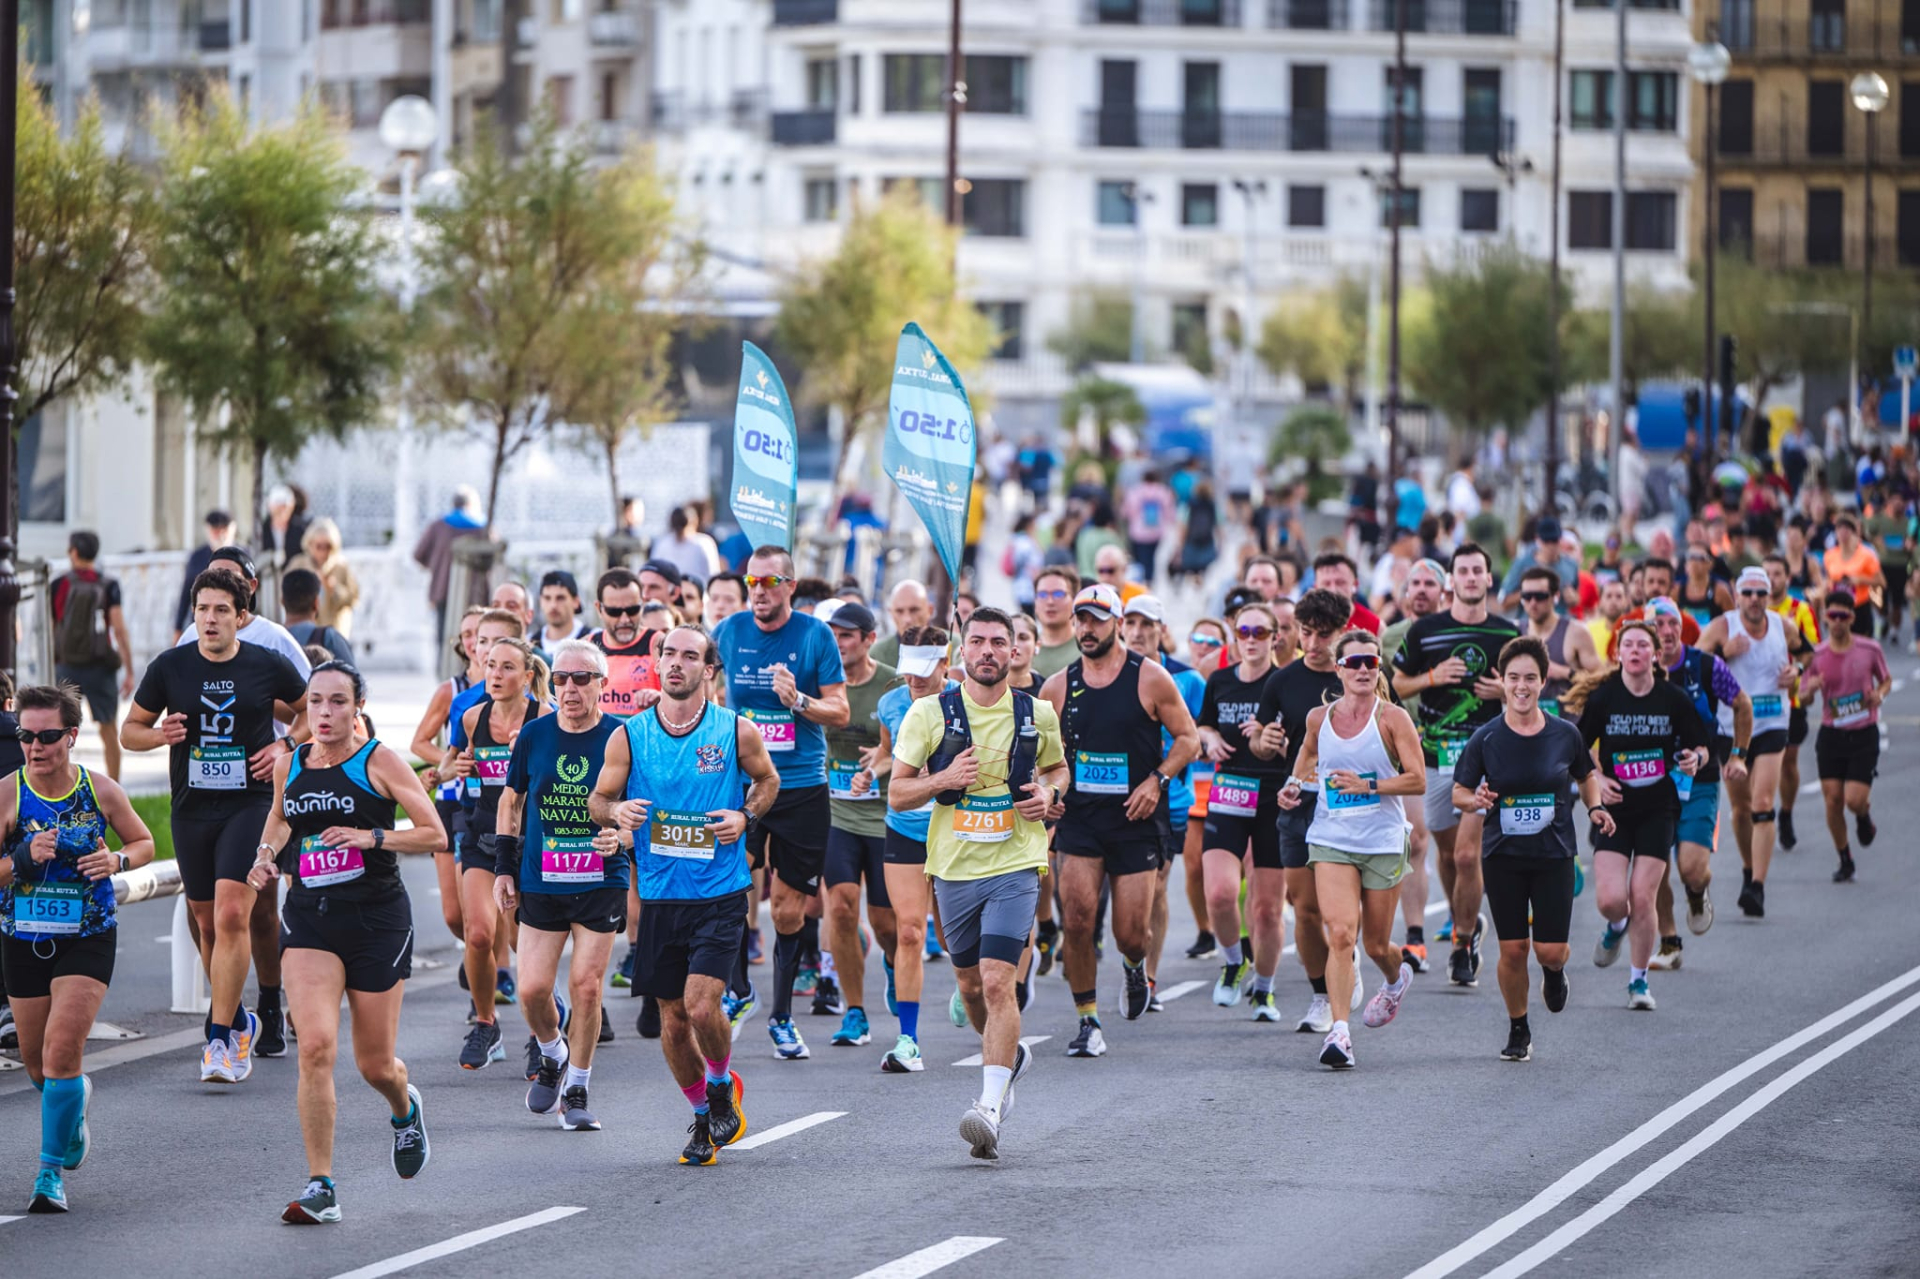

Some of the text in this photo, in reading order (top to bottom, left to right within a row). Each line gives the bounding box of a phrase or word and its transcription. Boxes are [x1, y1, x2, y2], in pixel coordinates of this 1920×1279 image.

[203, 681, 235, 691] SALTO
[760, 724, 785, 738] 492
[202, 763, 231, 776] 850
[486, 761, 510, 774] 126
[565, 764, 579, 775] 40
[1083, 766, 1118, 780] 2025
[1624, 760, 1656, 777] 1136
[552, 783, 589, 795] MEDIO
[1218, 787, 1250, 804] 1489
[543, 795, 588, 807] MARATO
[540, 808, 592, 823] NAVAJA
[963, 811, 1004, 828] 2761
[1514, 808, 1541, 822] 938
[660, 825, 705, 843] 3015
[307, 849, 349, 870] 1167
[552, 853, 592, 868] 1177
[27, 899, 71, 917] 1563
